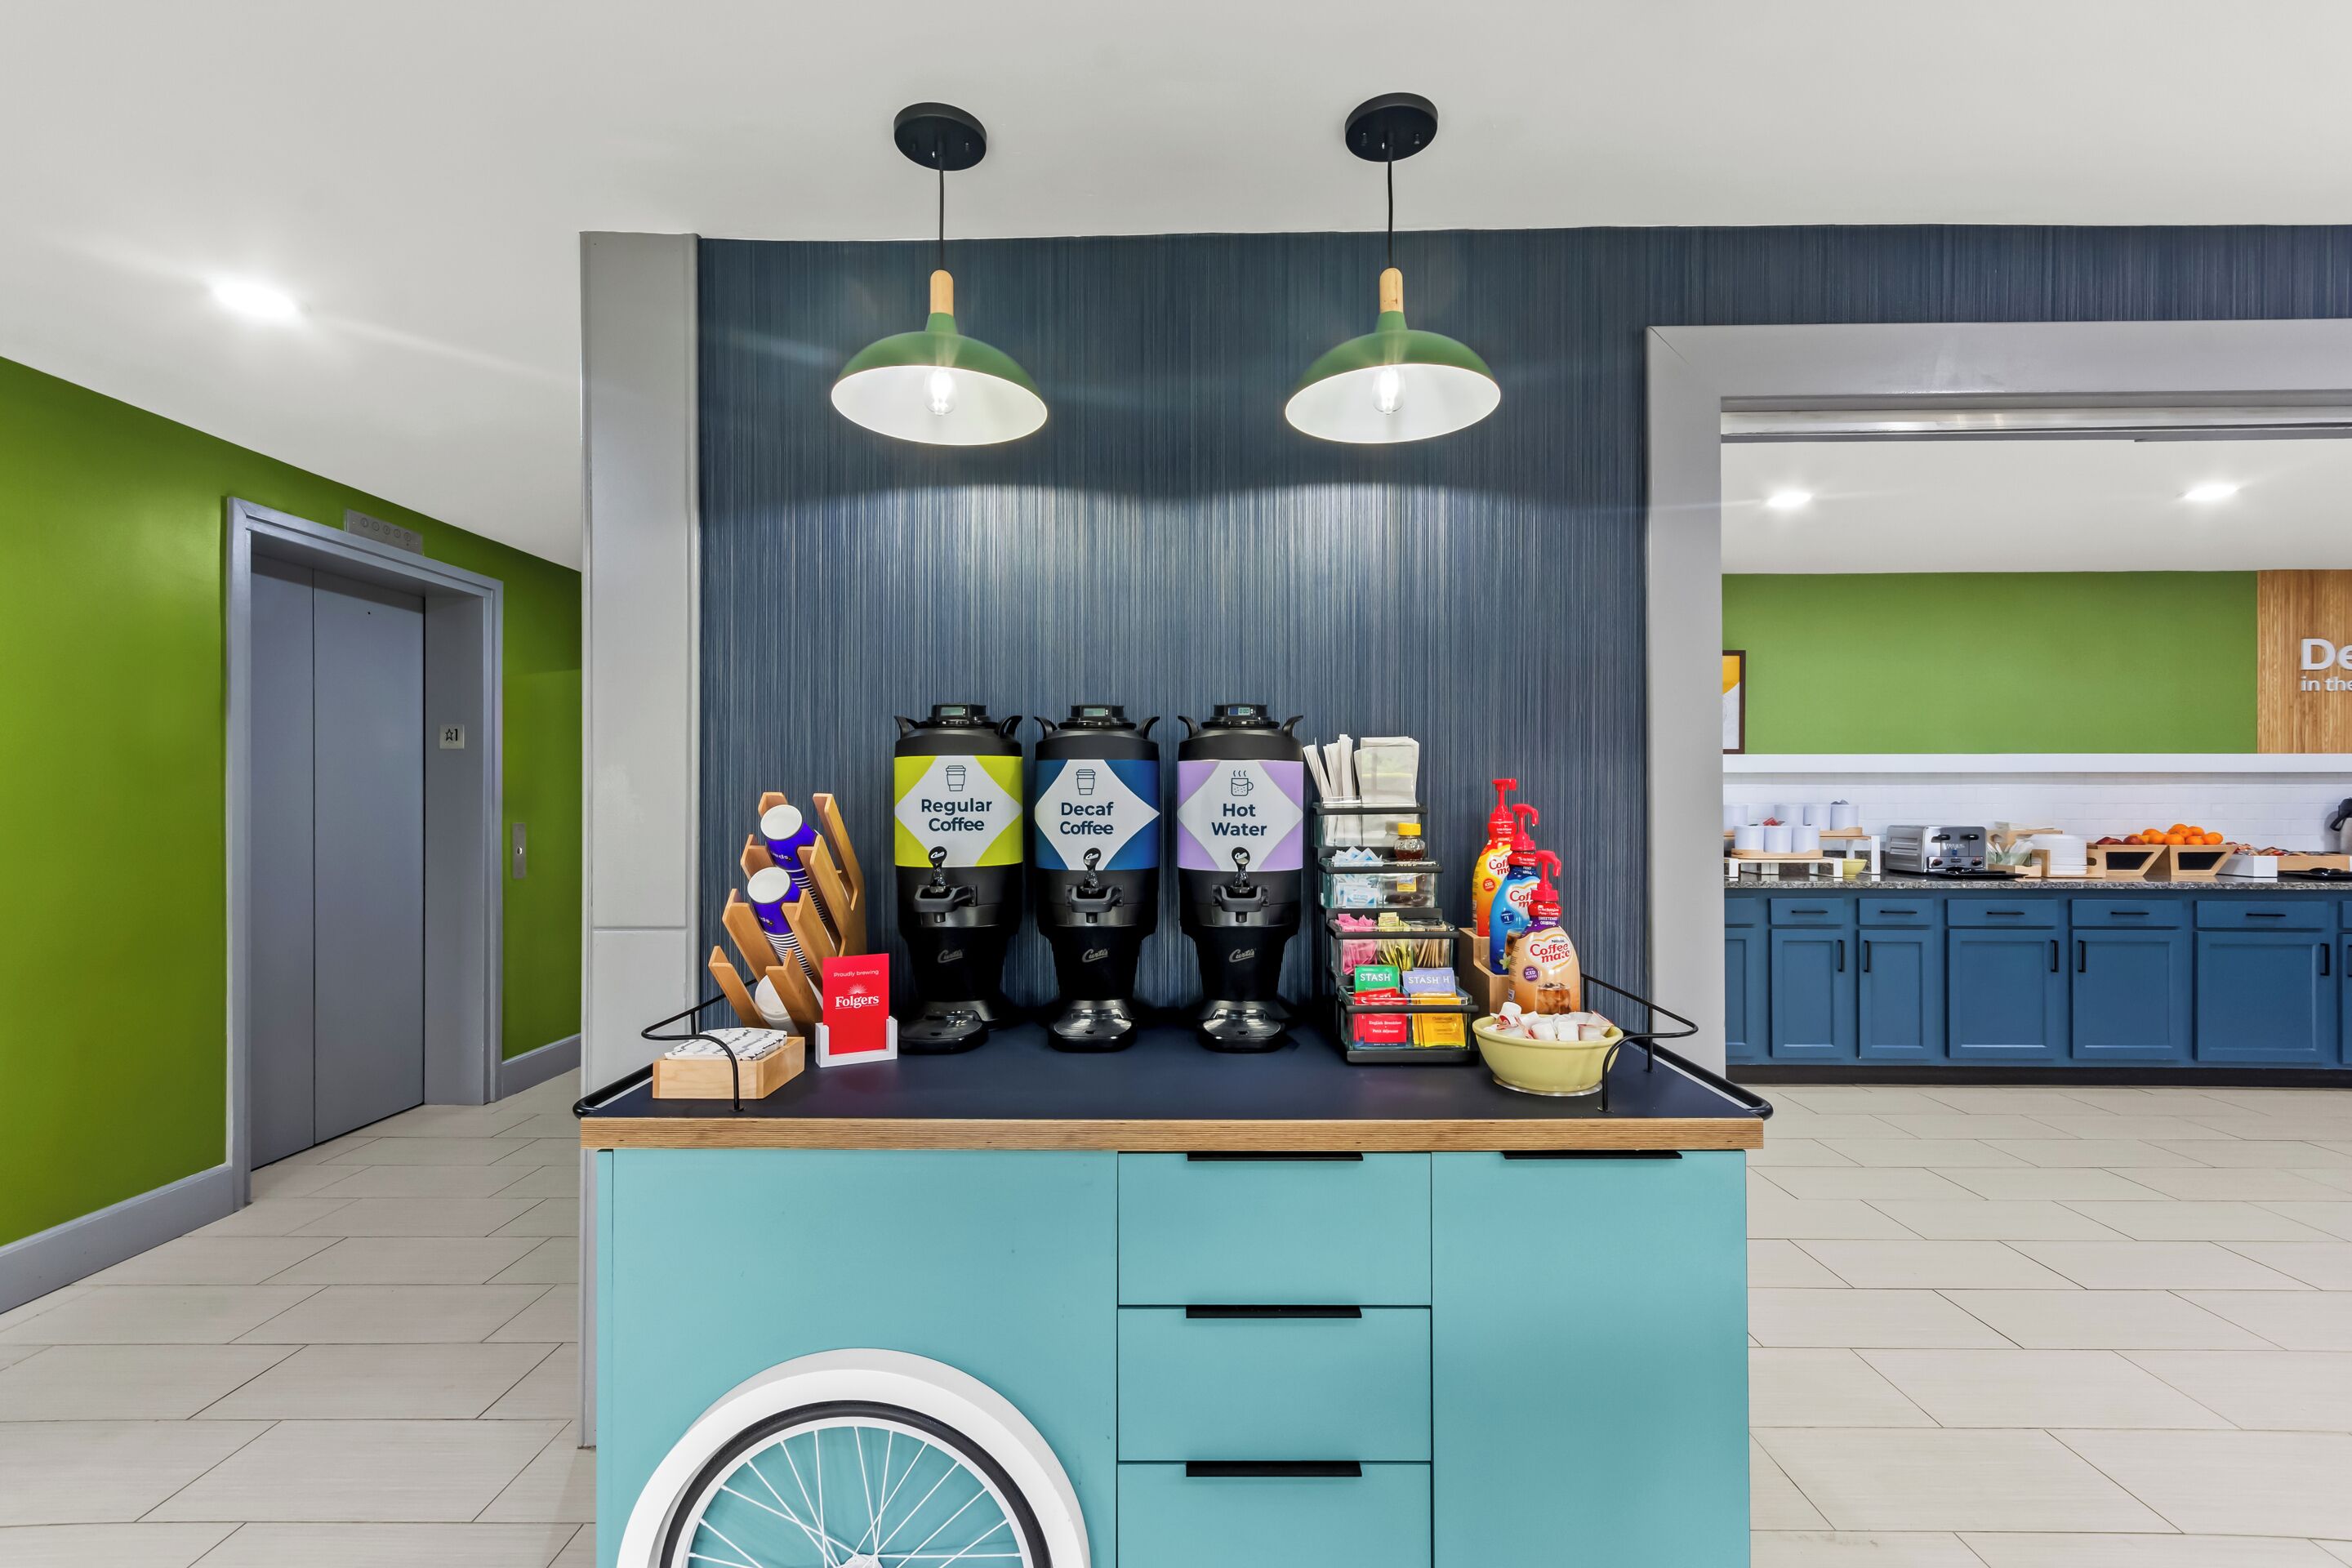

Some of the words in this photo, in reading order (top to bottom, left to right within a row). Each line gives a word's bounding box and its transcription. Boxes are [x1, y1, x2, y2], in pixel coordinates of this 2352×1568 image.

[2301, 638, 2352, 670] De
[2301, 675, 2320, 692] in
[921, 798, 992, 816] Regular
[1061, 802, 1114, 816] Decaf
[1223, 804, 1256, 817] Hot
[929, 817, 985, 831] Coffee
[1060, 821, 1114, 835] Coffee
[1211, 822, 1267, 836] Water
[1530, 943, 1568, 956] Coffee
[1360, 973, 1391, 982] STASH
[835, 996, 880, 1009] Folgers
